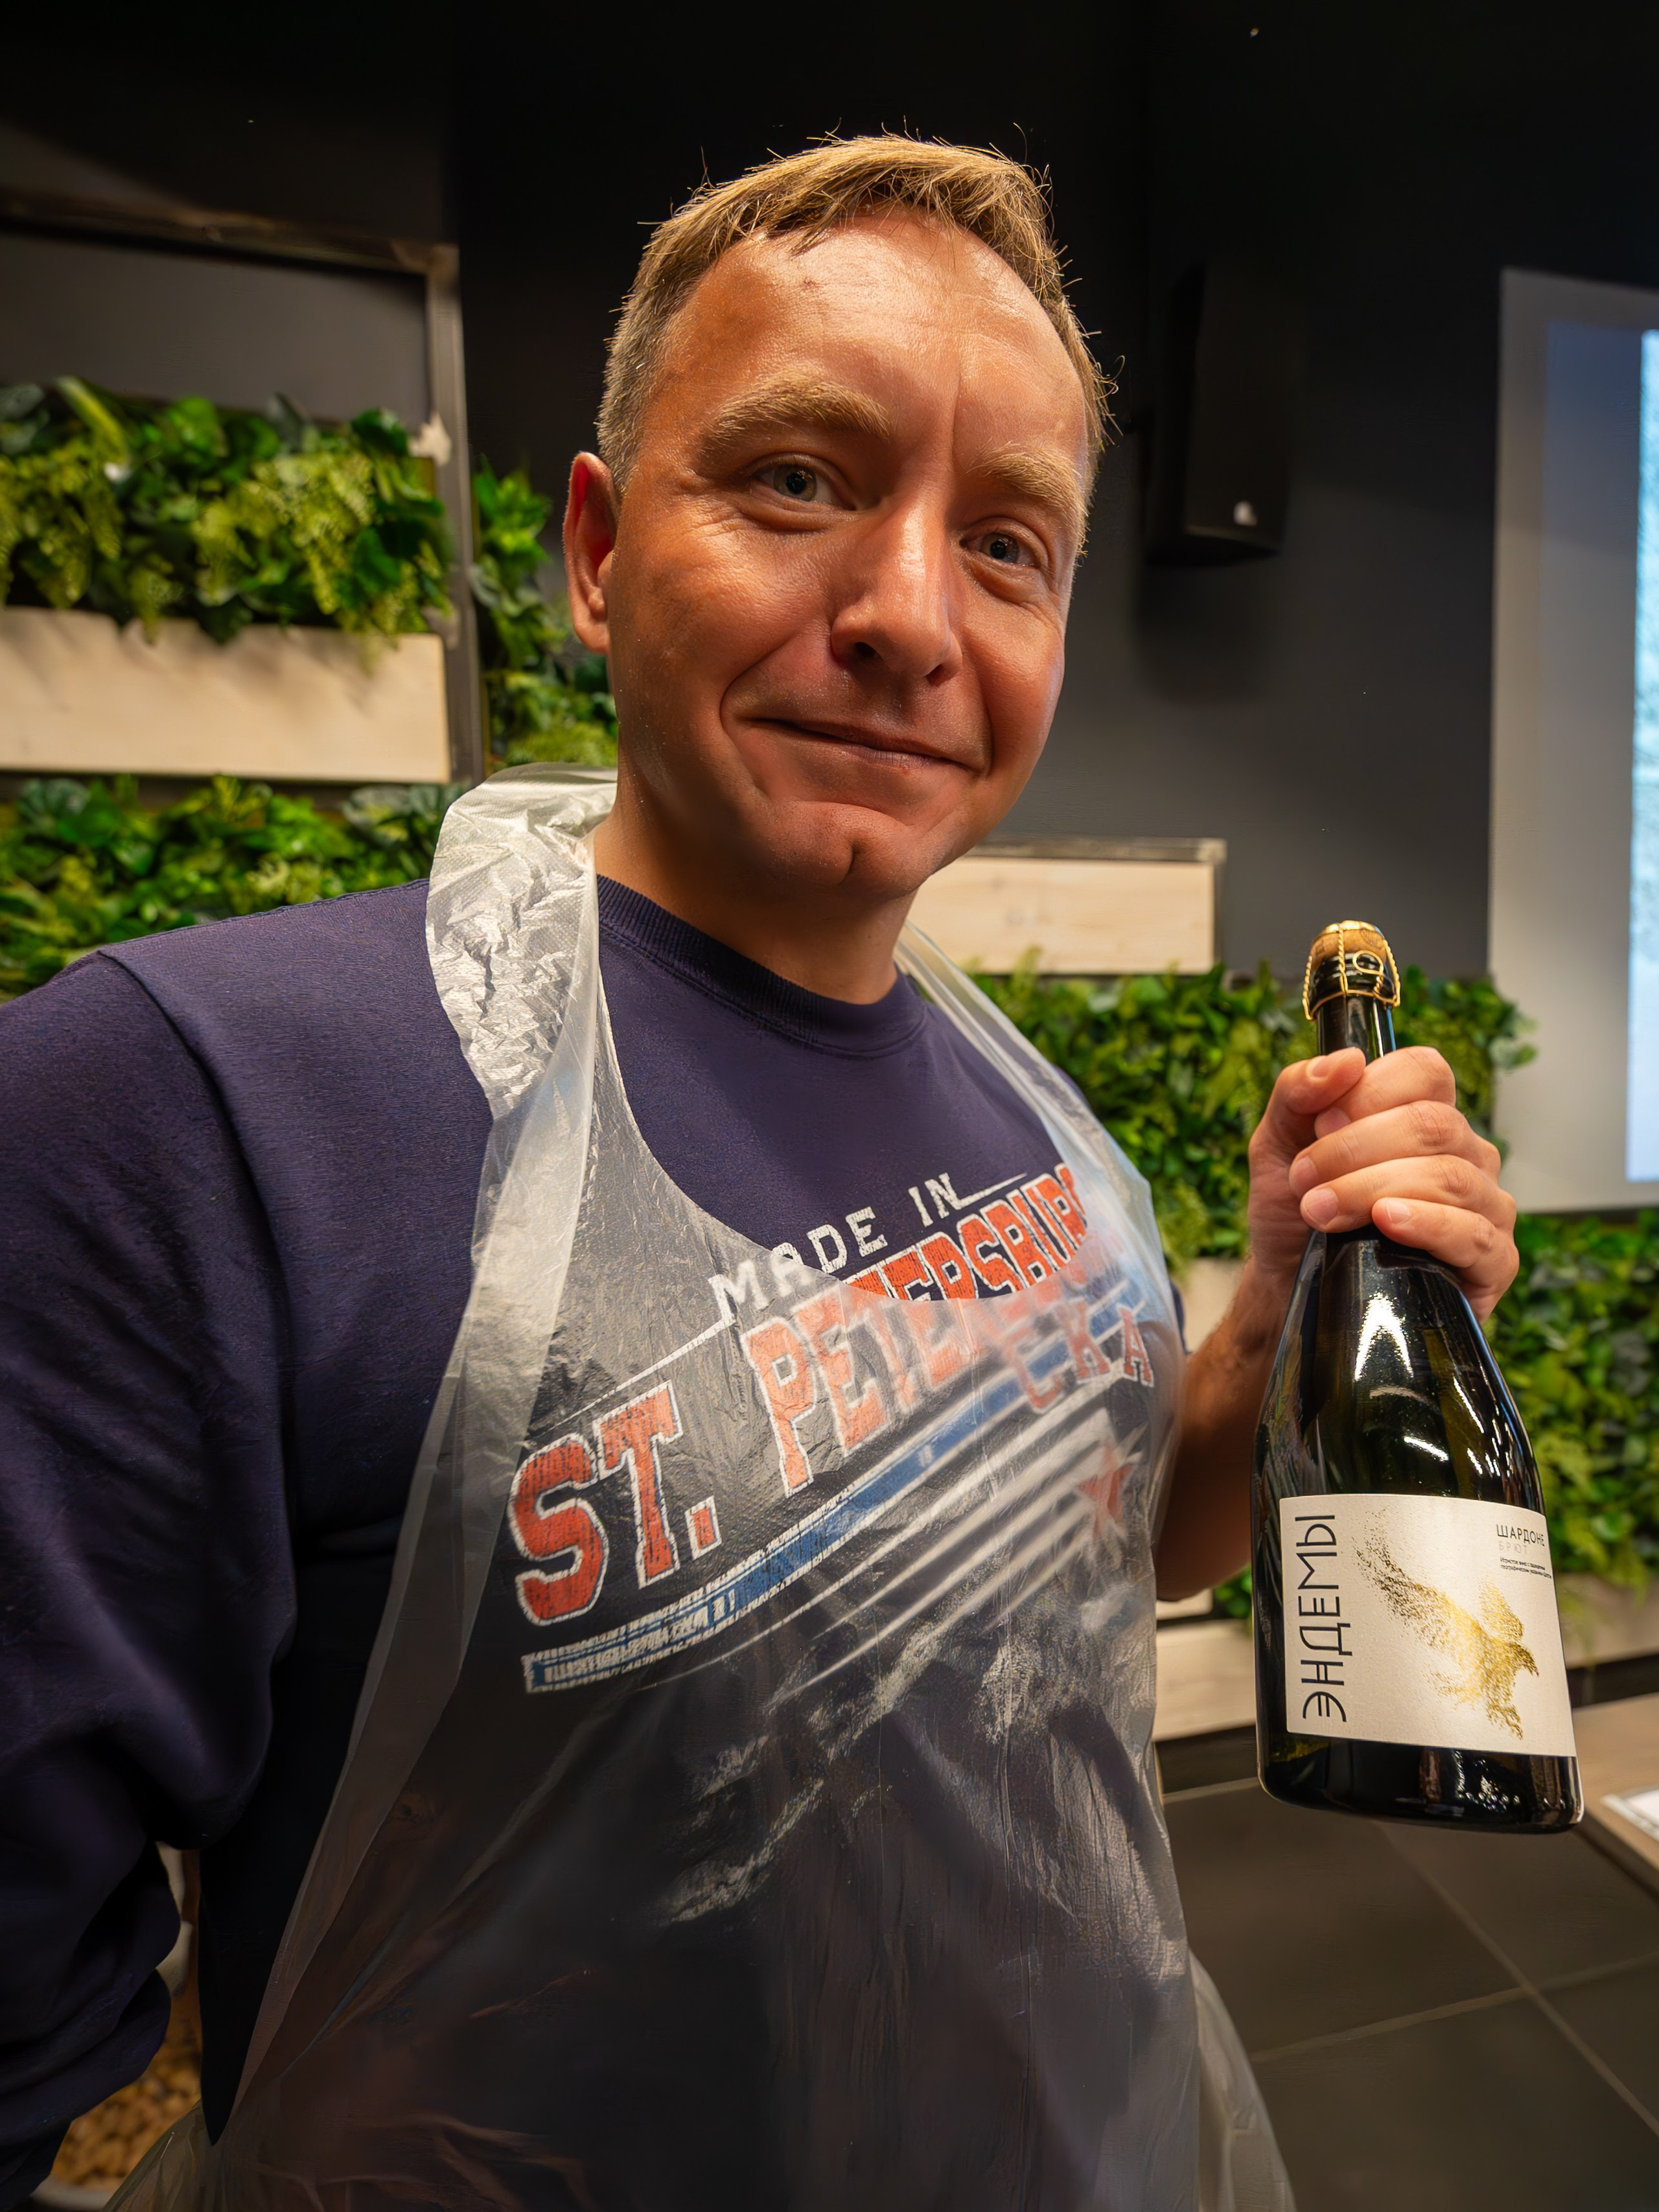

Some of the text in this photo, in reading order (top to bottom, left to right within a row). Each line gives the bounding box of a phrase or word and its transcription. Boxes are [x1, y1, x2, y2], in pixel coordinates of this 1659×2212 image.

[708, 1172, 964, 1323] MADE IN
[506, 1379, 722, 1625] ST.
[1496, 1524, 1545, 1546] ШАРДОНЕ
[1295, 1515, 1352, 1722] ЭНДЕМЫ
